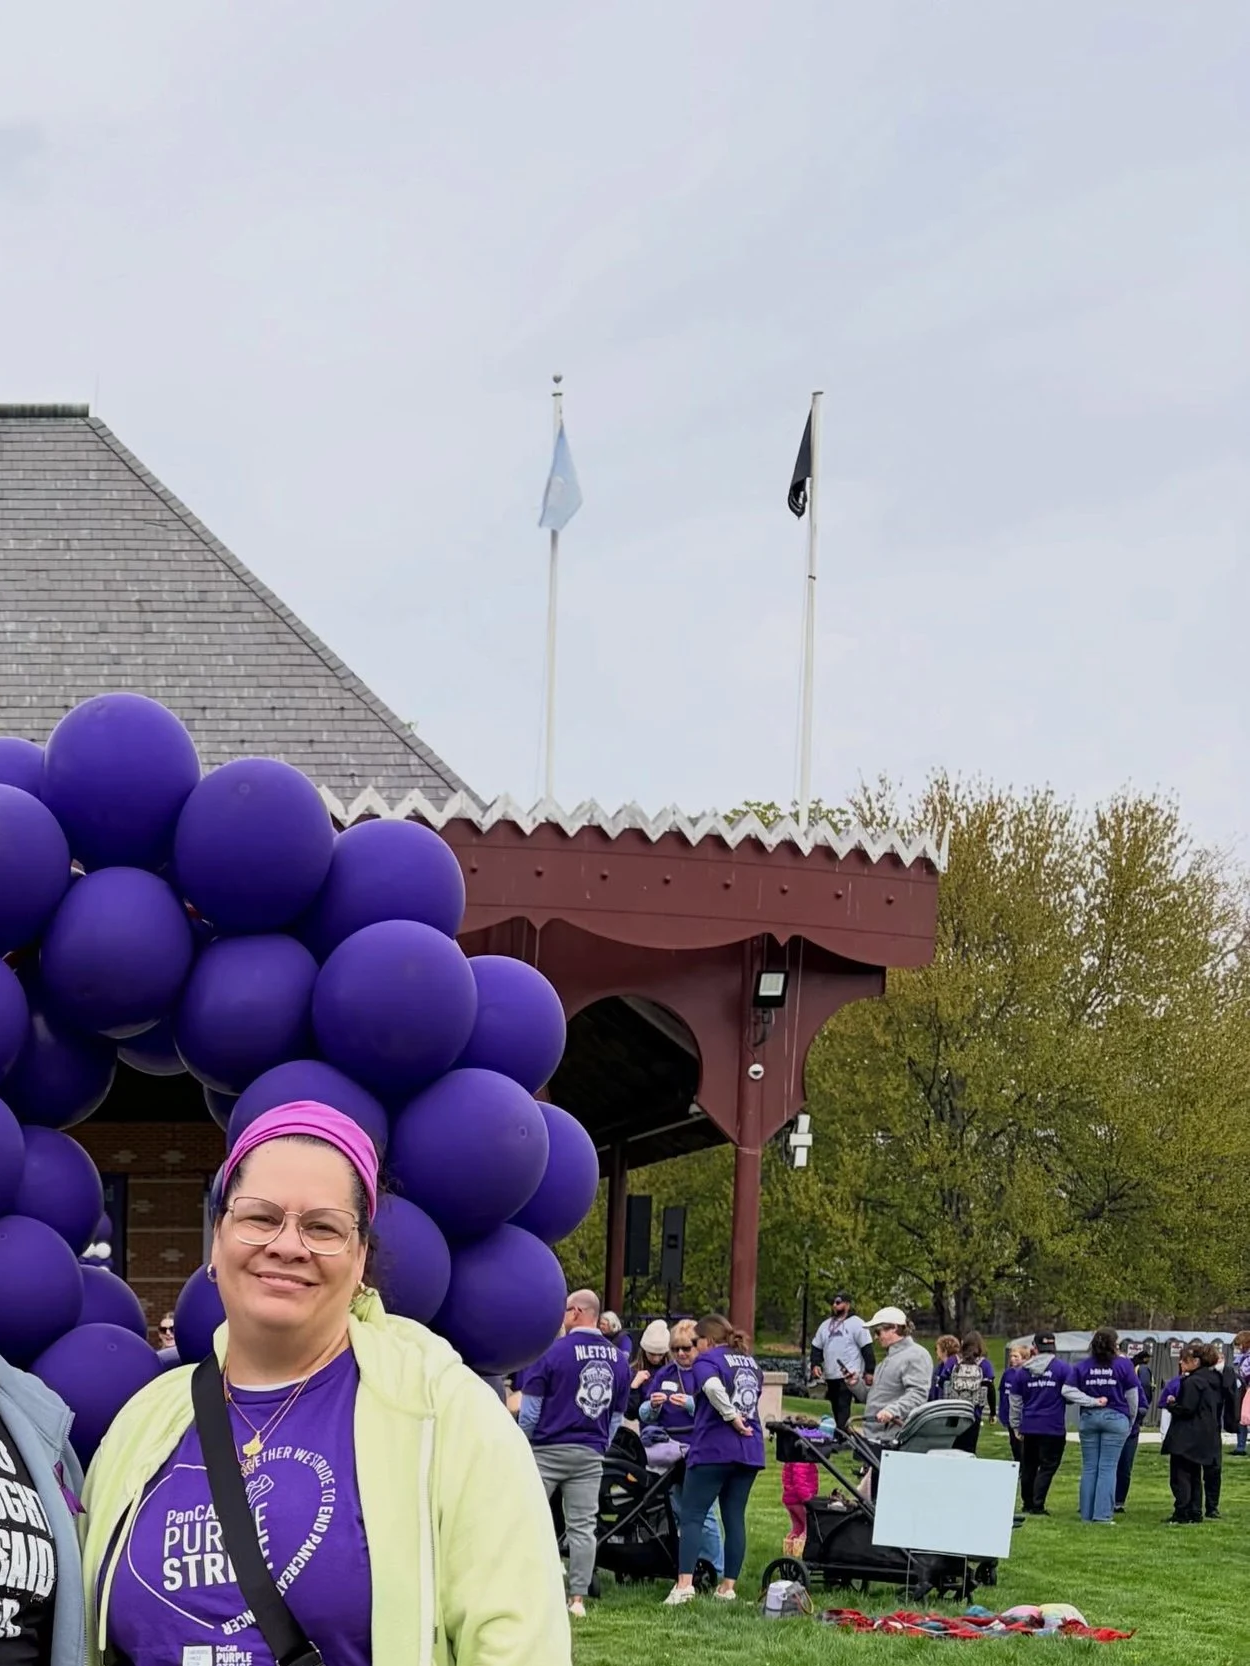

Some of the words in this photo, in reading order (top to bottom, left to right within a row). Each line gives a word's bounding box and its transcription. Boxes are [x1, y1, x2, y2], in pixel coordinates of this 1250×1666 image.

[254, 1445, 293, 1468] ETHER
[293, 1447, 313, 1465] WE
[309, 1453, 336, 1488] STRIDE
[321, 1488, 336, 1503] TO
[165, 1504, 220, 1526] PanCA
[312, 1506, 334, 1533] END
[164, 1502, 269, 1558] PURE
[162, 1535, 274, 1592] STRIE
[275, 1532, 323, 1597] PANCREAT
[221, 1609, 257, 1635] NCER
[216, 1651, 253, 1663] PURPLE
